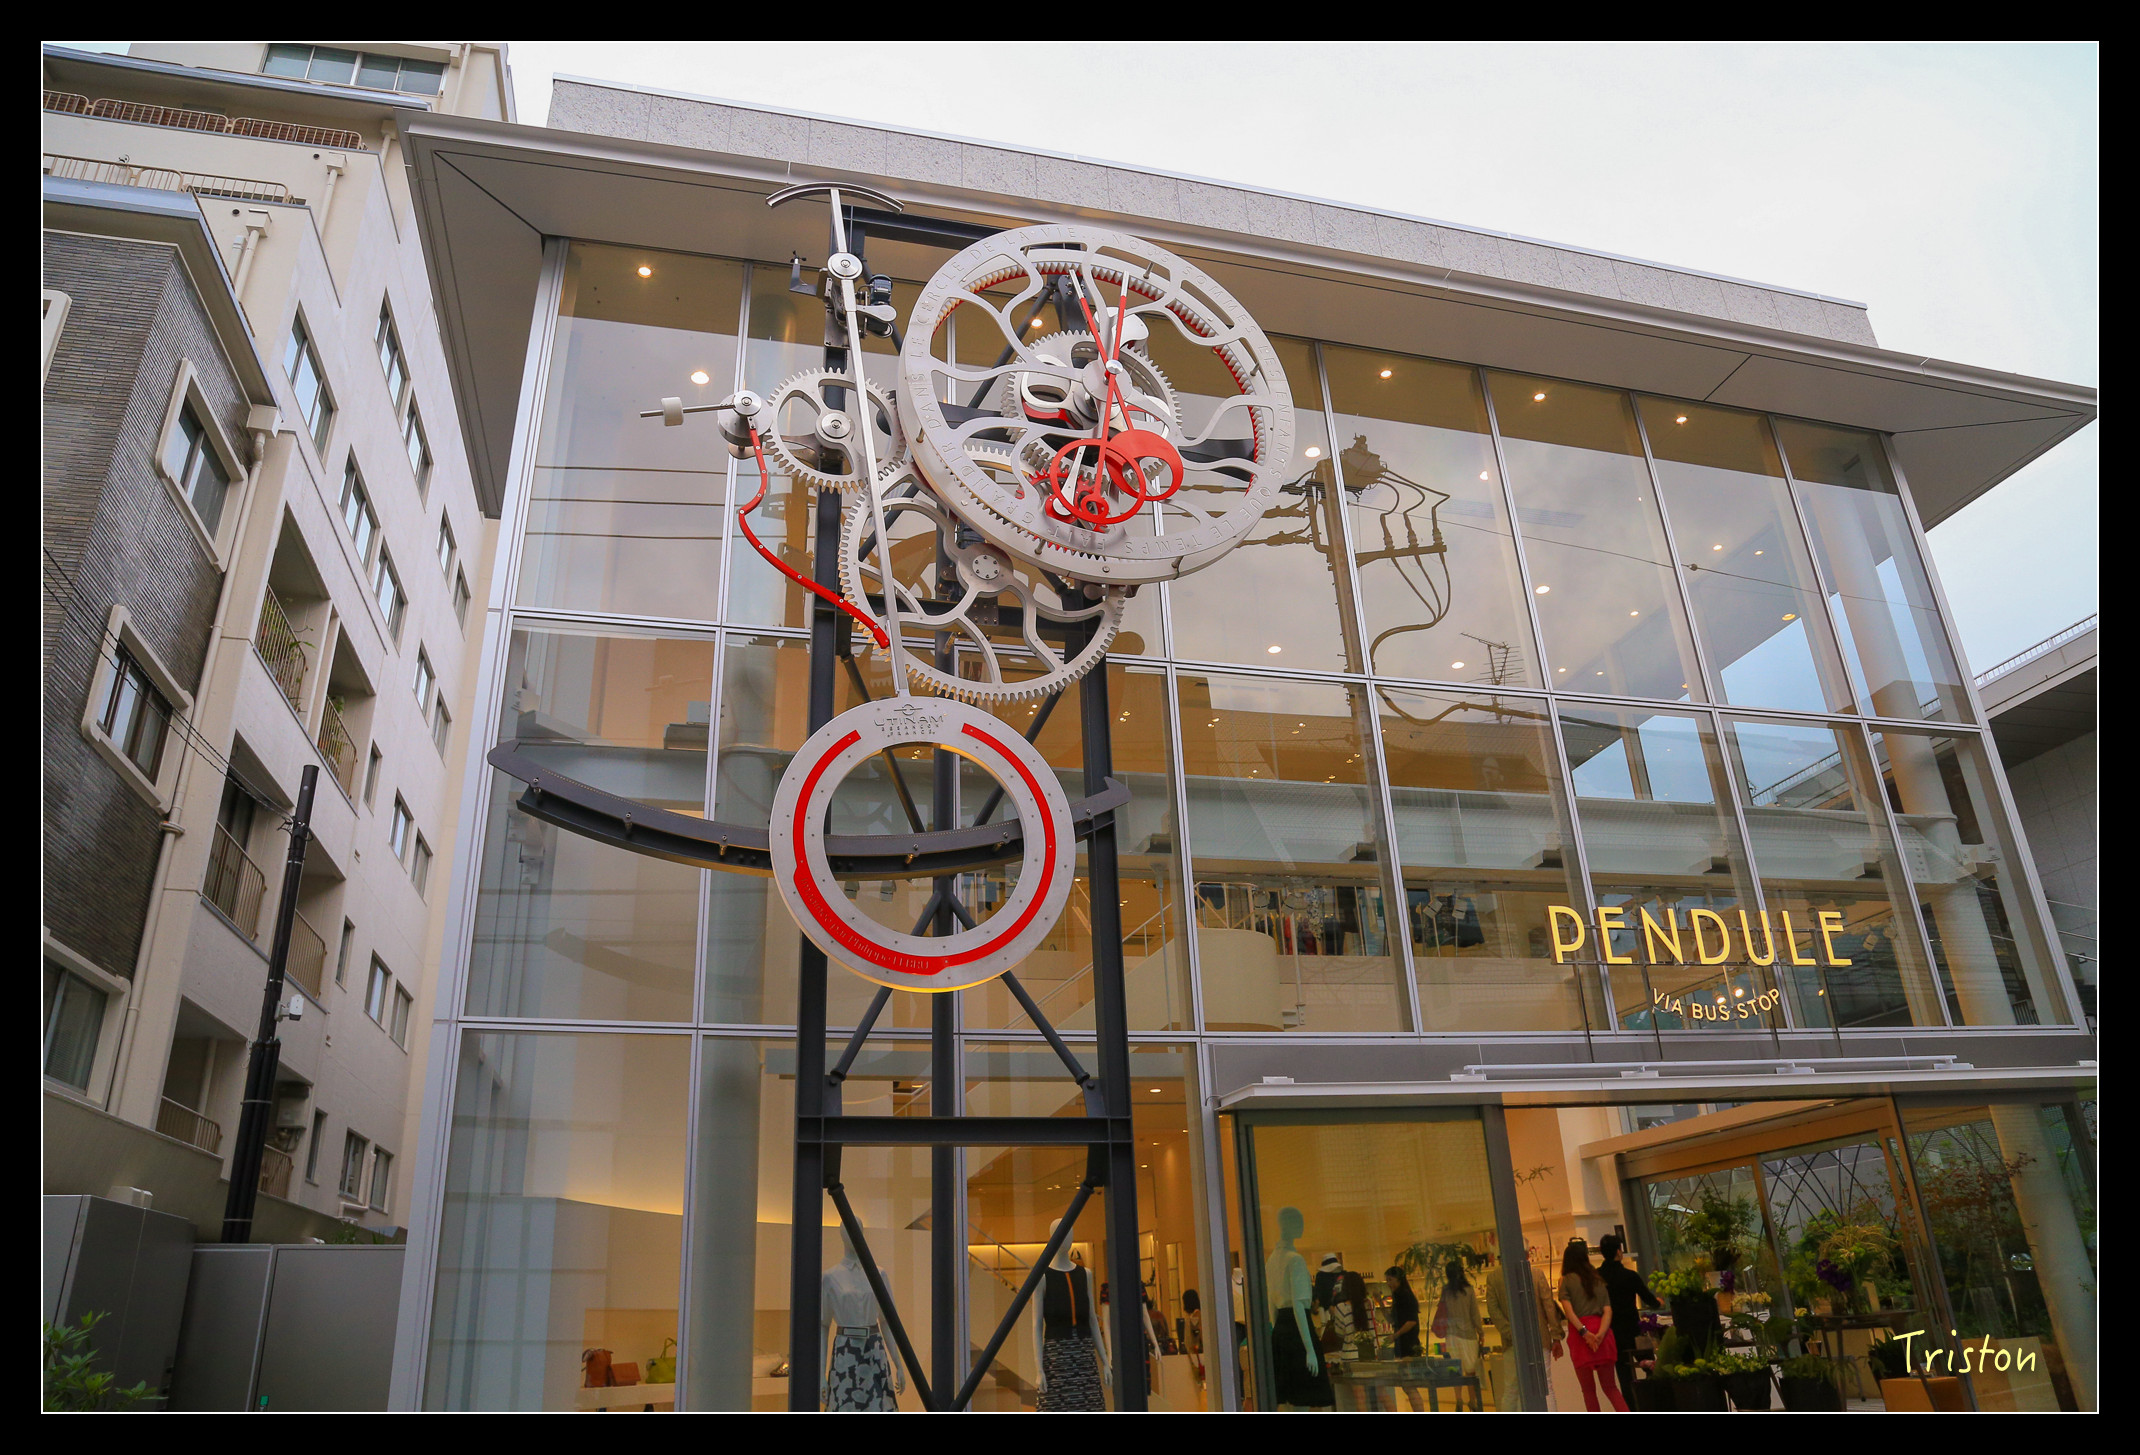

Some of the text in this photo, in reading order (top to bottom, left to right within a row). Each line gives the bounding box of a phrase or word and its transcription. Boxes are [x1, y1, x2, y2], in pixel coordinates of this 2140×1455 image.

[969, 241, 996, 261] DE
[1003, 231, 1030, 245] LA
[1182, 265, 1257, 333] SOMMES
[1547, 905, 1852, 966] PENDULE
[1652, 987, 1780, 1021] VIA BUS STOP
